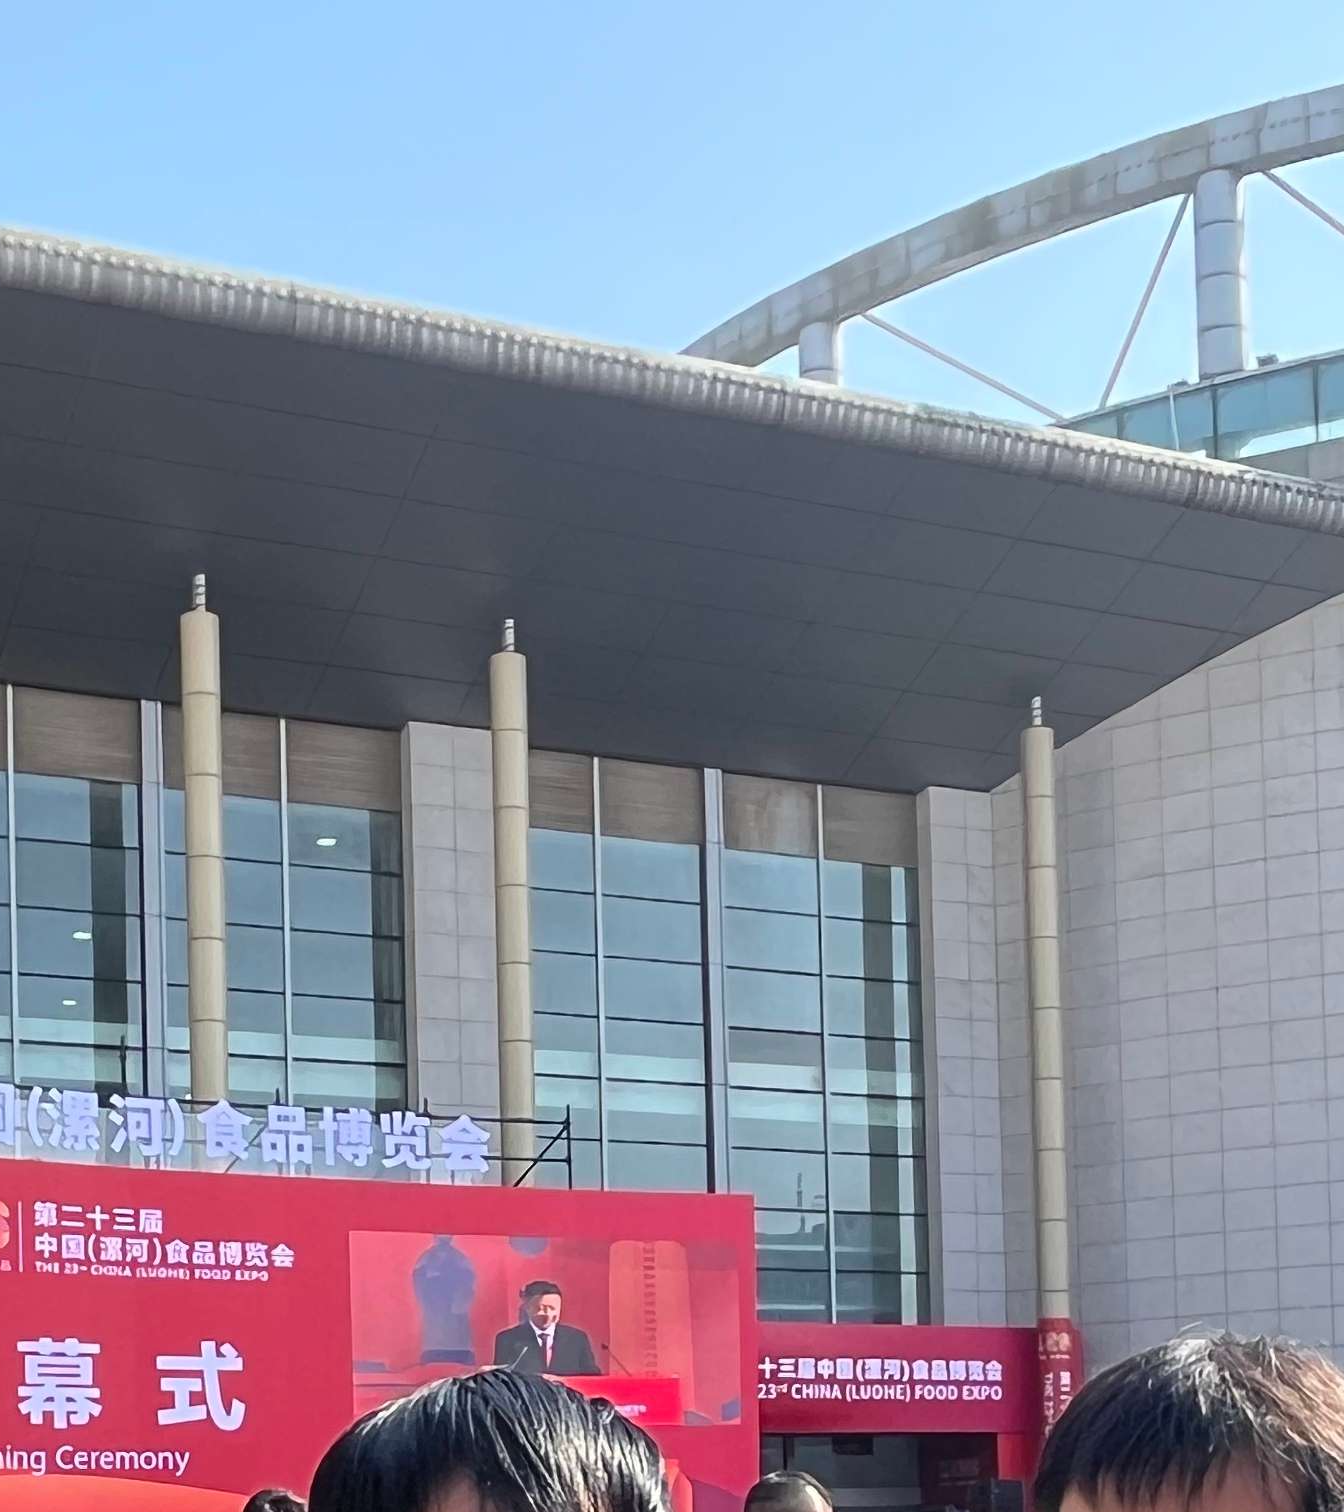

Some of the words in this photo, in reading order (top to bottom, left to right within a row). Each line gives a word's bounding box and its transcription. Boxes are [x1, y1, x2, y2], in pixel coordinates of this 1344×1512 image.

[33, 1200, 164, 1236] 第二十三届
[33, 1232, 296, 1269] 中国(漯河)食品博览会
[791, 1384, 842, 1400] CHINA
[845, 1384, 911, 1403] (LUOHE)
[914, 1385, 958, 1400] FOOD
[962, 1385, 1003, 1400] EXPO
[54, 1445, 191, 1478] Ceremony
